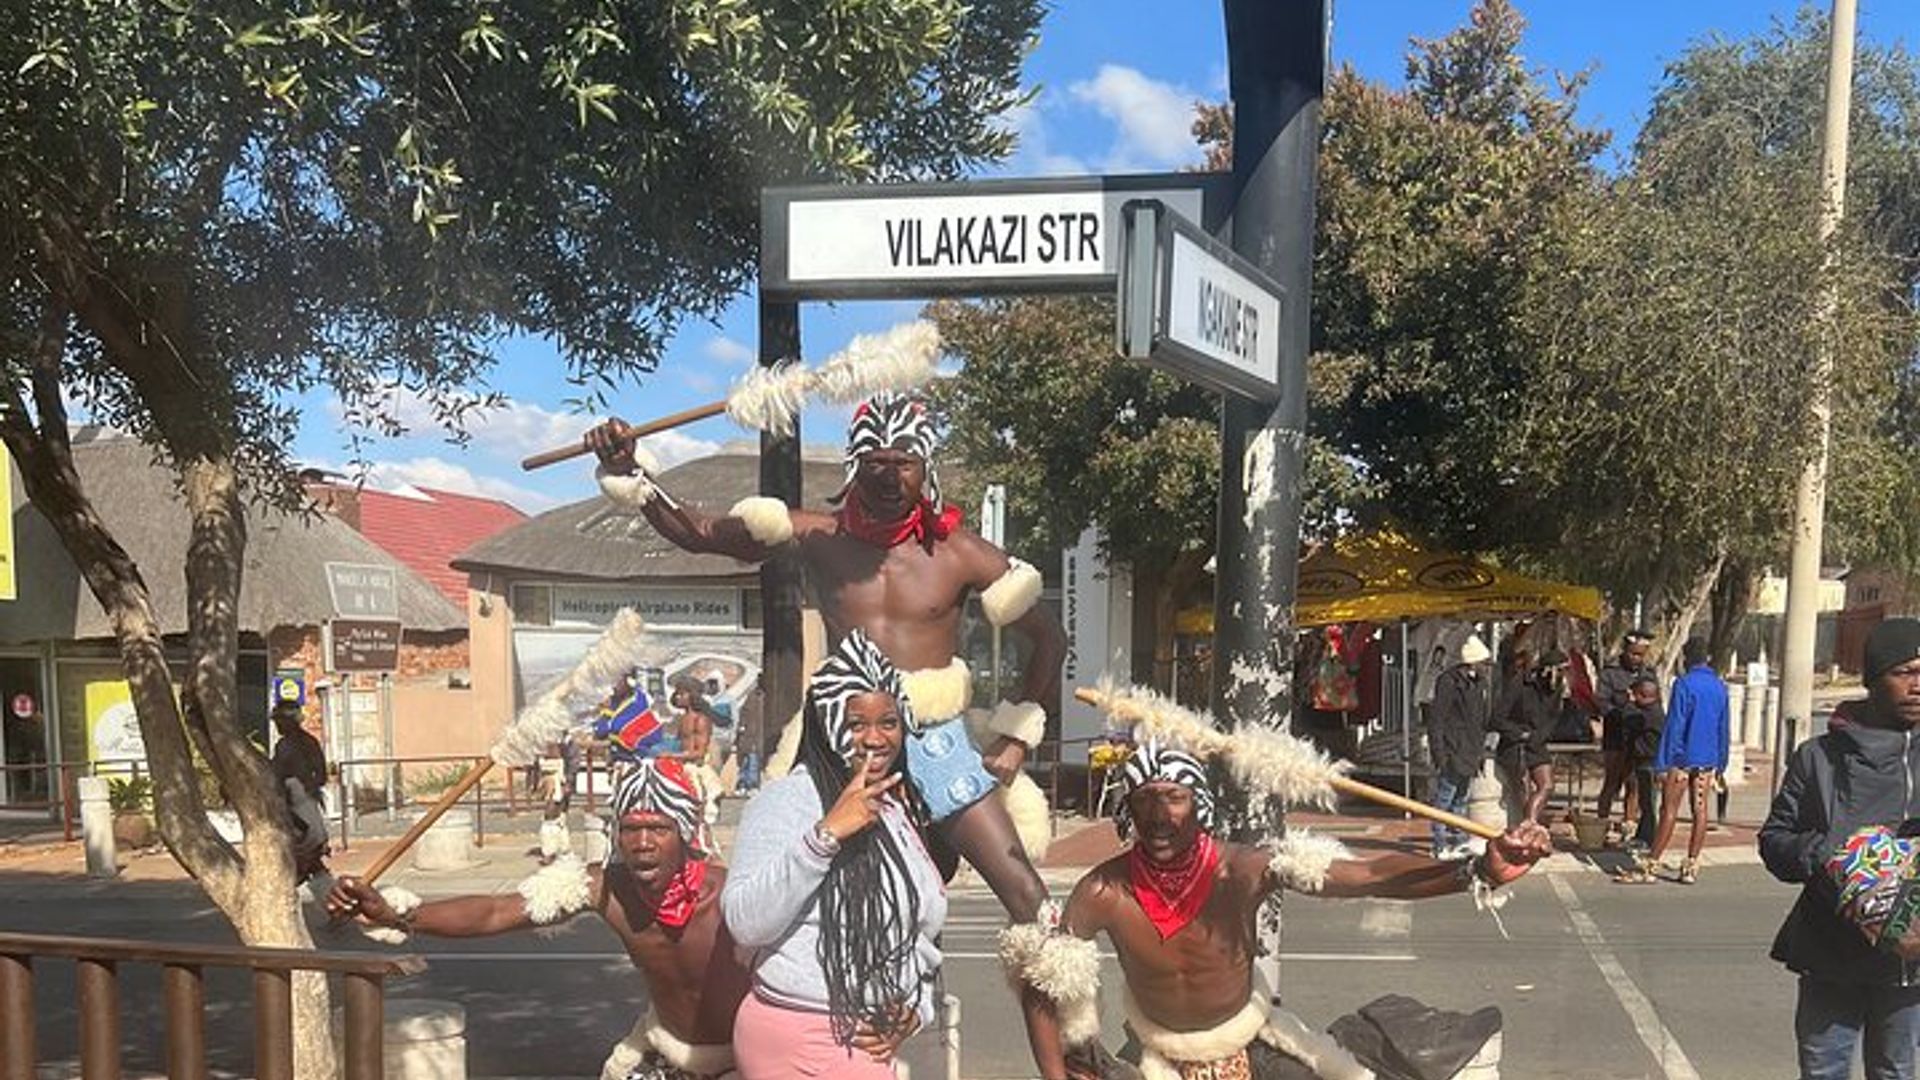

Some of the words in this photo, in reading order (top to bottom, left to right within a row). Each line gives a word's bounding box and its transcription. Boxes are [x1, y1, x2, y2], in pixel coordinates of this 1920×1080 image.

[885, 215, 1027, 267] VILAKAZI
[1037, 212, 1099, 263] STR
[693, 602, 731, 615] Rides
